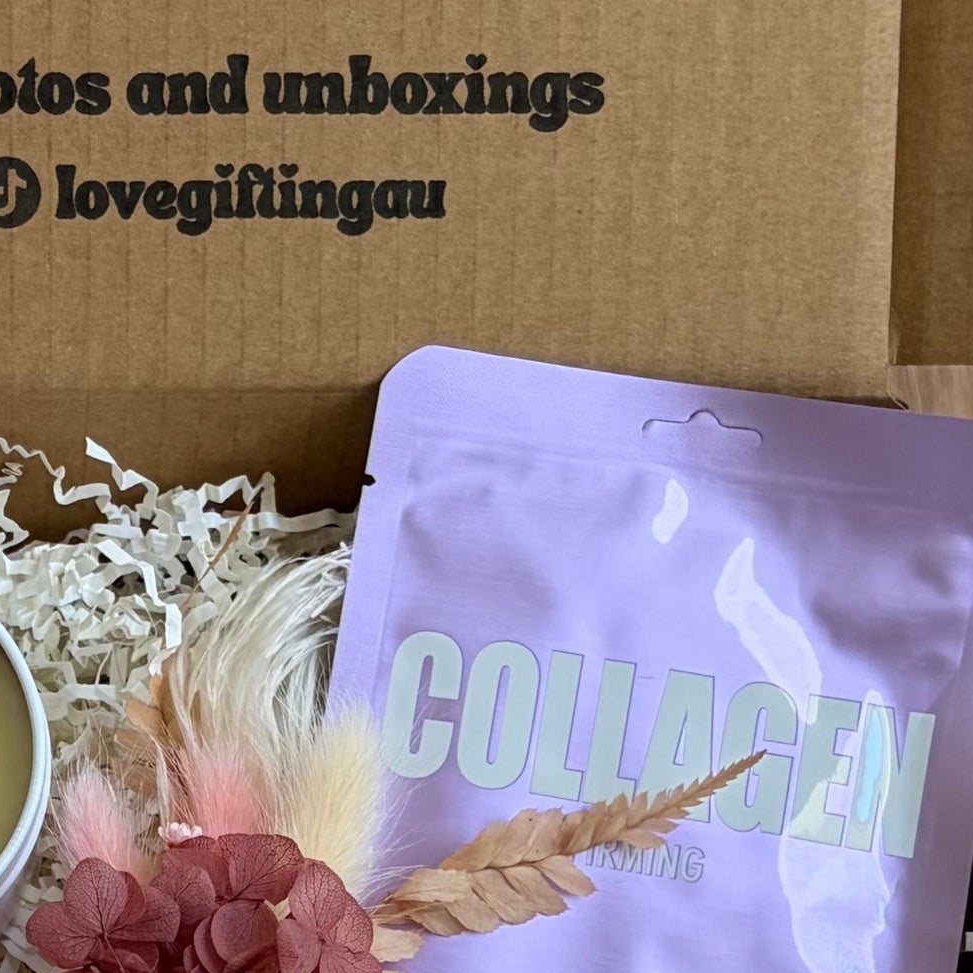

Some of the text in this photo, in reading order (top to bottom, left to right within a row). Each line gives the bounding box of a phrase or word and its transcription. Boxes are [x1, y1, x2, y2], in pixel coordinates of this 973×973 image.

[127, 54, 249, 115] and
[263, 54, 604, 132] unboxings
[56, 164, 446, 236] lovegiftingau
[380, 631, 936, 858] COLLAGEN
[572, 841, 705, 883] IRMING
